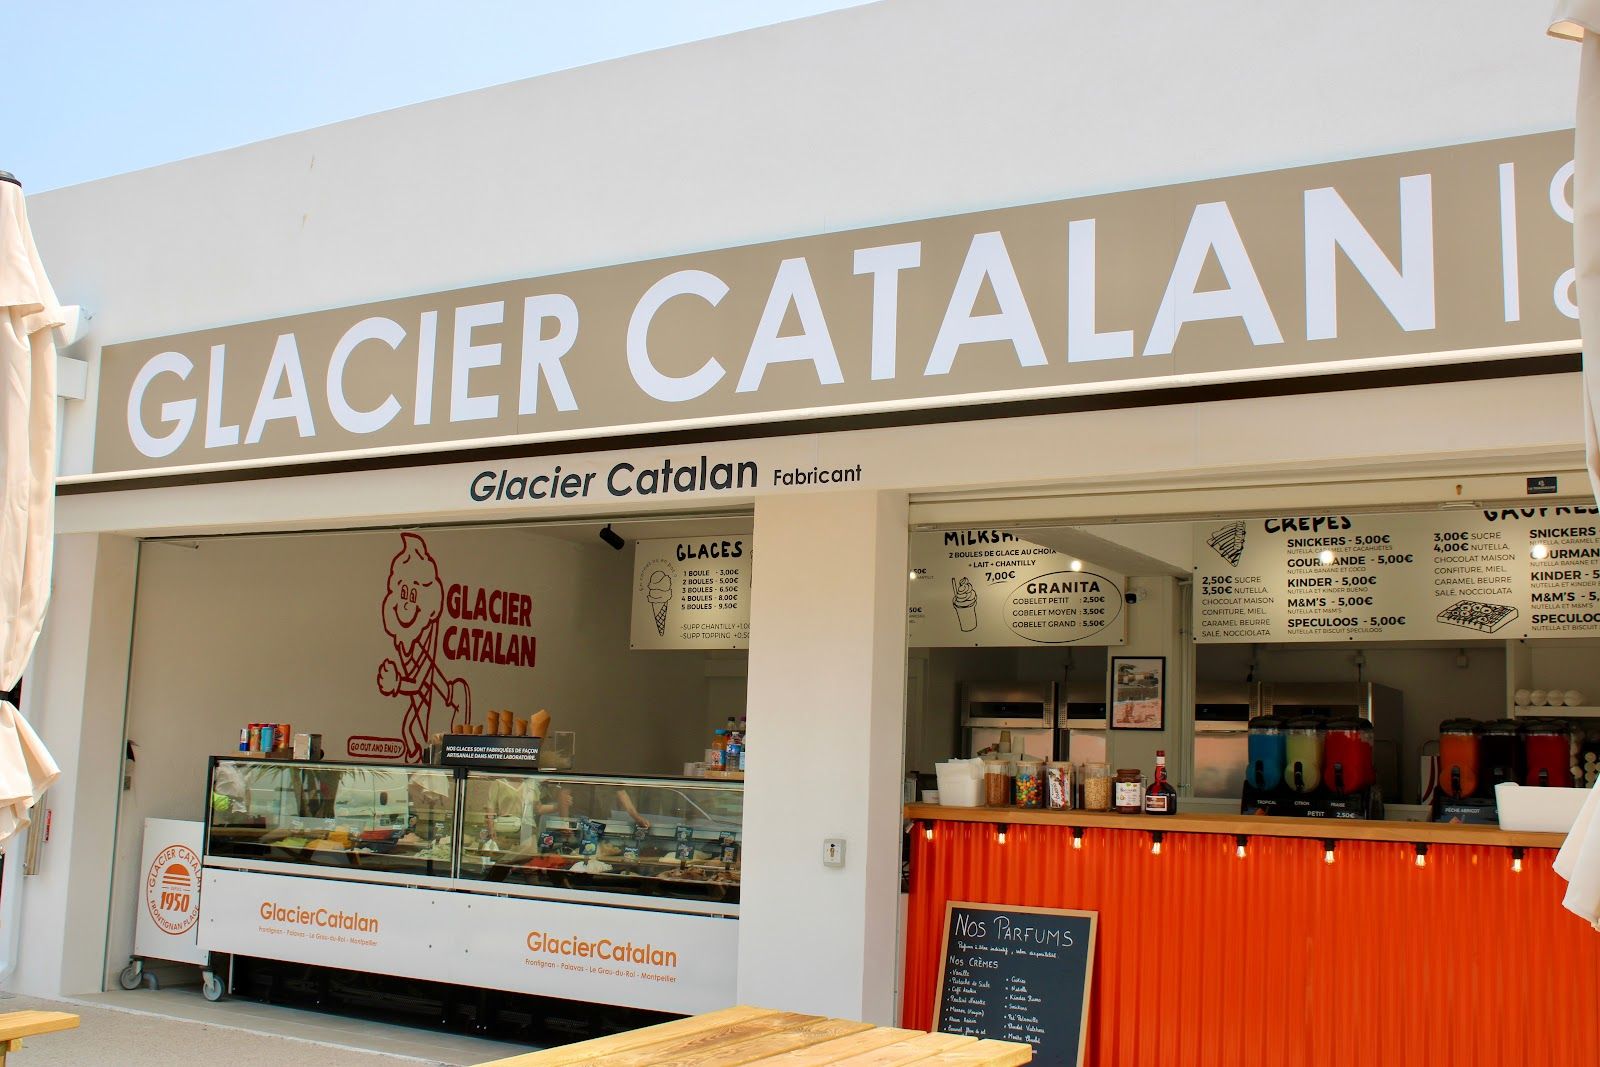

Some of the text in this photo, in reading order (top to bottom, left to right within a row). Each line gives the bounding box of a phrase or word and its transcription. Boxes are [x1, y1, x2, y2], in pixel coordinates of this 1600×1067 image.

[127, 173, 1436, 459] GLACIER CATALAN
[470, 456, 862, 502] Glacier Catalan Fabricant
[1434, 532, 1501, 542] 3,00€ SUCRE
[1530, 527, 1596, 538] SNICKERS
[1287, 535, 1390, 547] SNICKERS 5,00€
[677, 541, 742, 561] GLACES
[1434, 543, 1468, 553] 4,00€
[1287, 555, 1413, 567] GOURANDE 5,00€
[986, 571, 1015, 581] 7,00€
[1202, 576, 1232, 585] 2,50€
[1287, 576, 1376, 587] KINDER 5,00€
[1531, 571, 1581, 580] KINDER
[1027, 581, 1100, 594] GRANITA
[1202, 586, 1232, 595] 3,50€
[1288, 597, 1373, 607] M&M'S 5,00€
[1531, 592, 1575, 602] M&M'S
[446, 583, 532, 627] GLACIER
[1288, 617, 1406, 627] SPECULOOS 5,00€
[442, 626, 536, 668] CATALAN
[360, 743, 371, 751] OUT
[372, 744, 383, 752] AND
[150, 849, 176, 887] GLACIER
[160, 892, 190, 912] 1950
[151, 900, 199, 930] FRONTIGNAN PLAGE
[260, 902, 379, 933] GlacierCatalan
[526, 931, 677, 967] GlacierCatalan
[525, 959, 556, 968] Frontignan
[561, 963, 584, 972] Palavas
[641, 973, 676, 982] Montpellier
